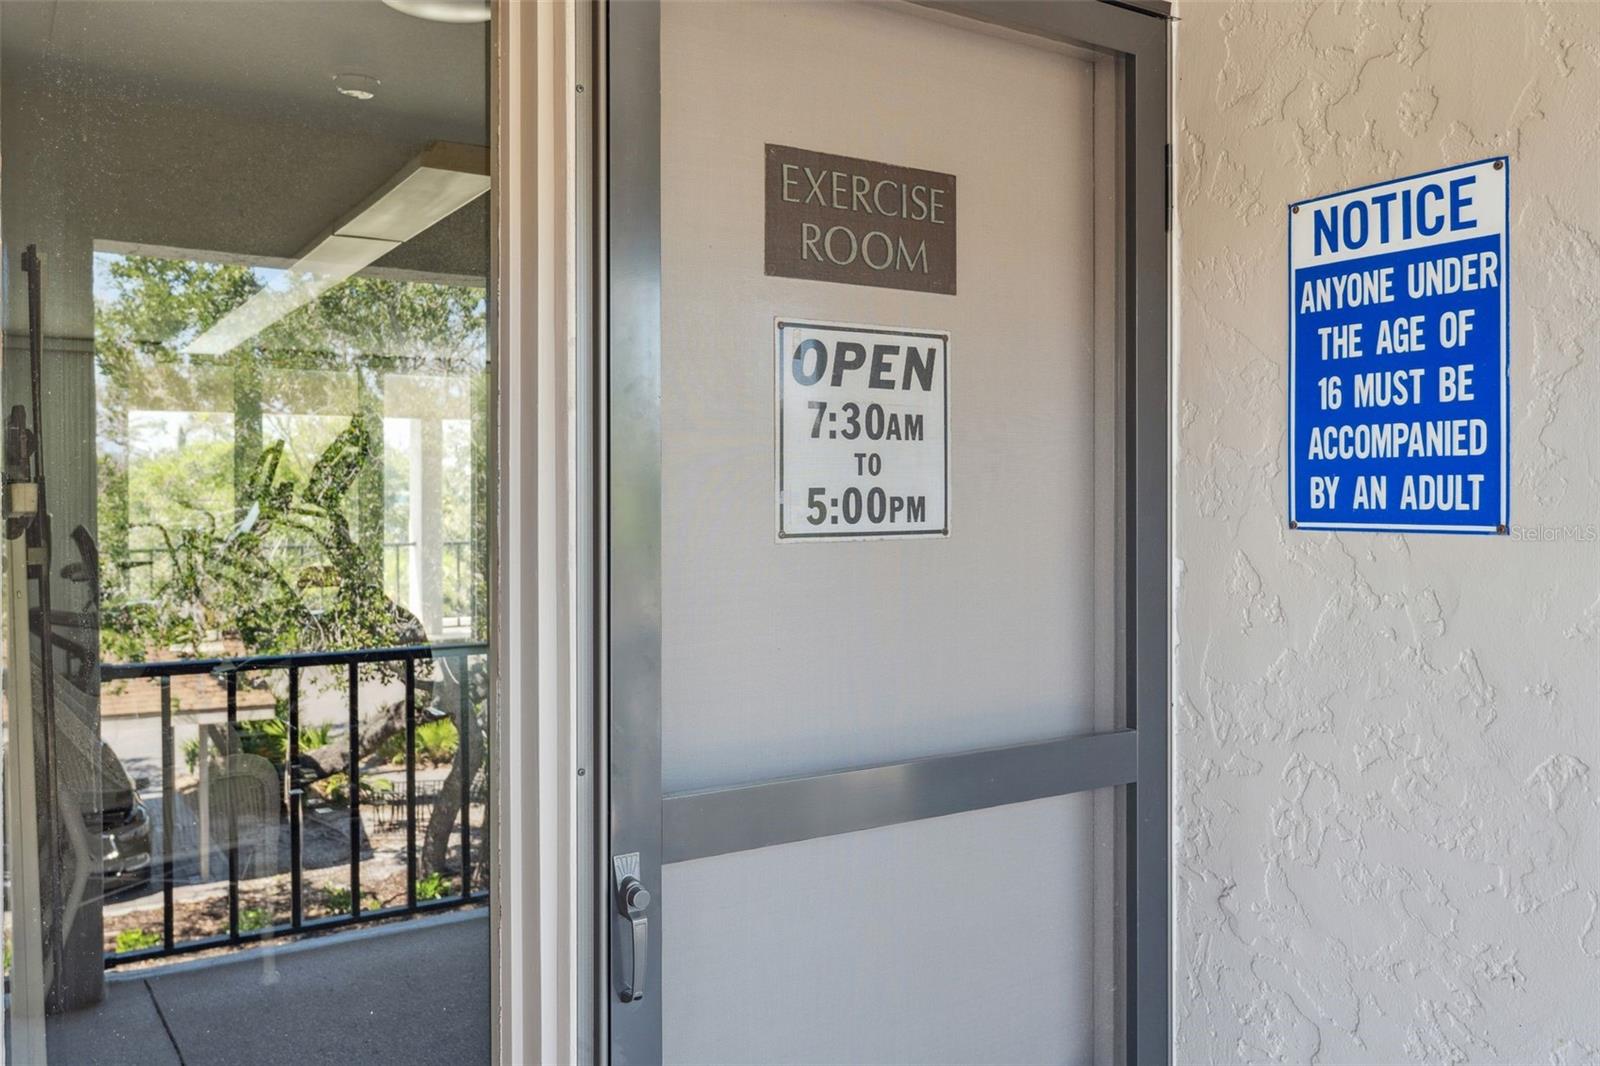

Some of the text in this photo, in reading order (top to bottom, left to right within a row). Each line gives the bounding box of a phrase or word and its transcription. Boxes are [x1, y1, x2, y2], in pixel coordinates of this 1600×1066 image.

[782, 163, 945, 224] EXERCISE
[1313, 175, 1478, 257] NOTICE
[801, 222, 929, 274] ROOM
[1300, 251, 1498, 314] ANYONE UNDER
[1317, 309, 1476, 361] THE AGE OF
[791, 338, 937, 391] OPEN
[1318, 364, 1475, 410] 16 MUST BE
[854, 452, 882, 477] TO
[1308, 418, 1488, 460] ACCOMPANIED
[1310, 474, 1485, 511] BY AN ADULT
